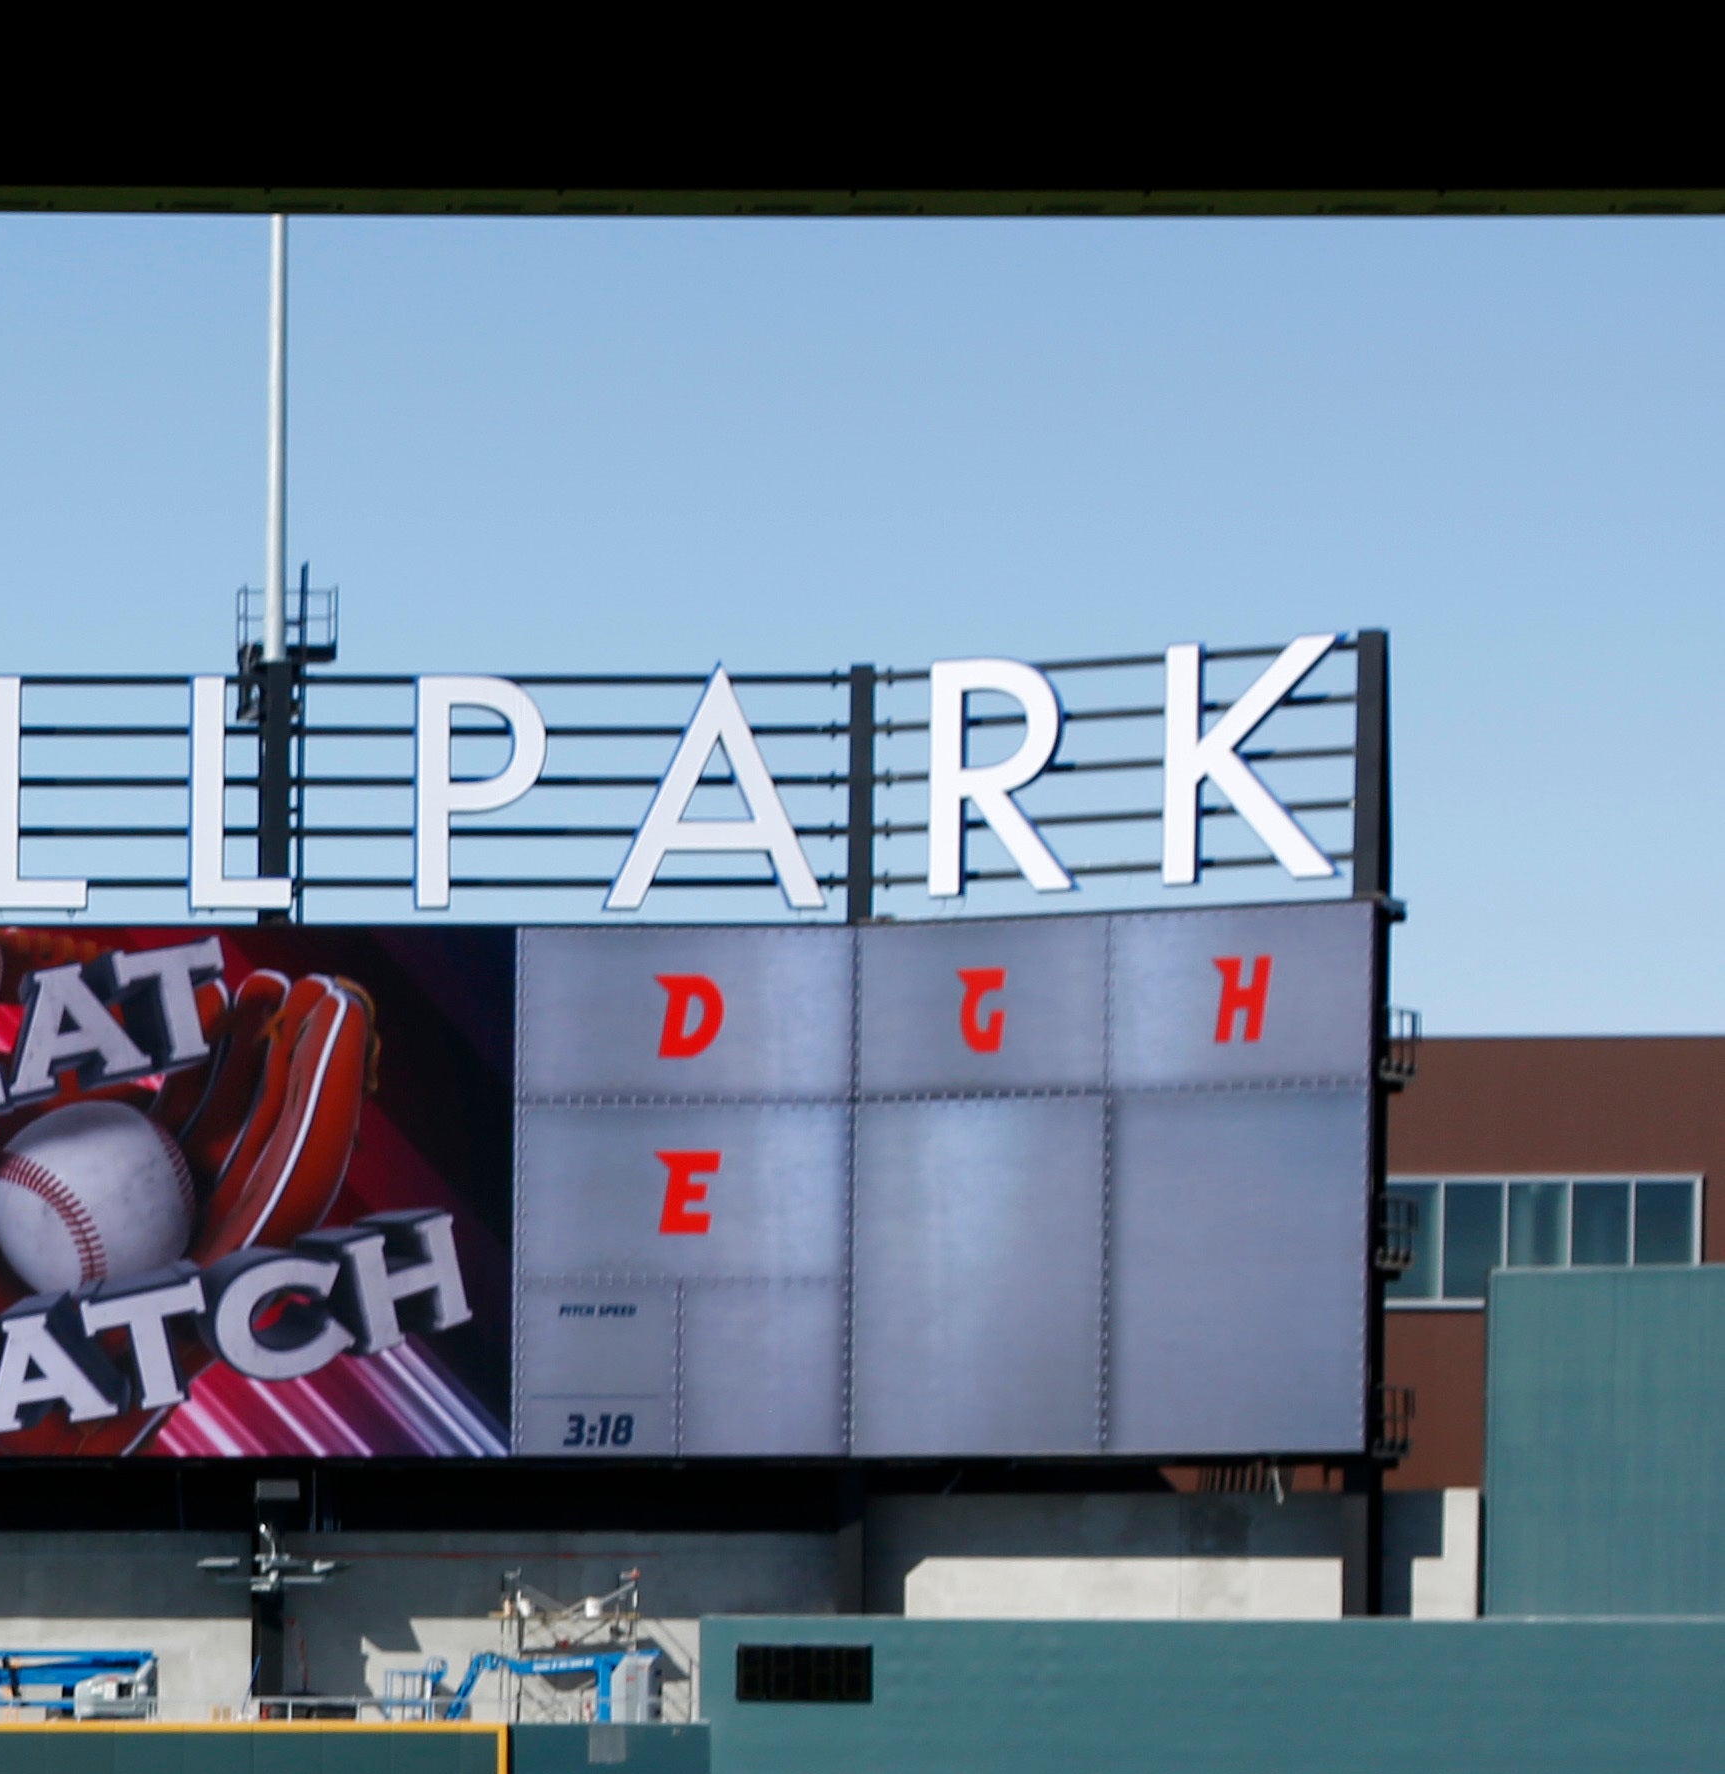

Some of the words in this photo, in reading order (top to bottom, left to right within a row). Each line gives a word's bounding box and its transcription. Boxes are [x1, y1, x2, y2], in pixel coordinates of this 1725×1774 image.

[654, 973, 725, 1059] D
[956, 967, 1007, 1053] G
[1212, 954, 1273, 1045] H
[654, 1150, 722, 1235] E
[558, 1304, 596, 1318] PITCH
[597, 1304, 638, 1318] SPEED
[562, 1412, 635, 1447] 3:18
